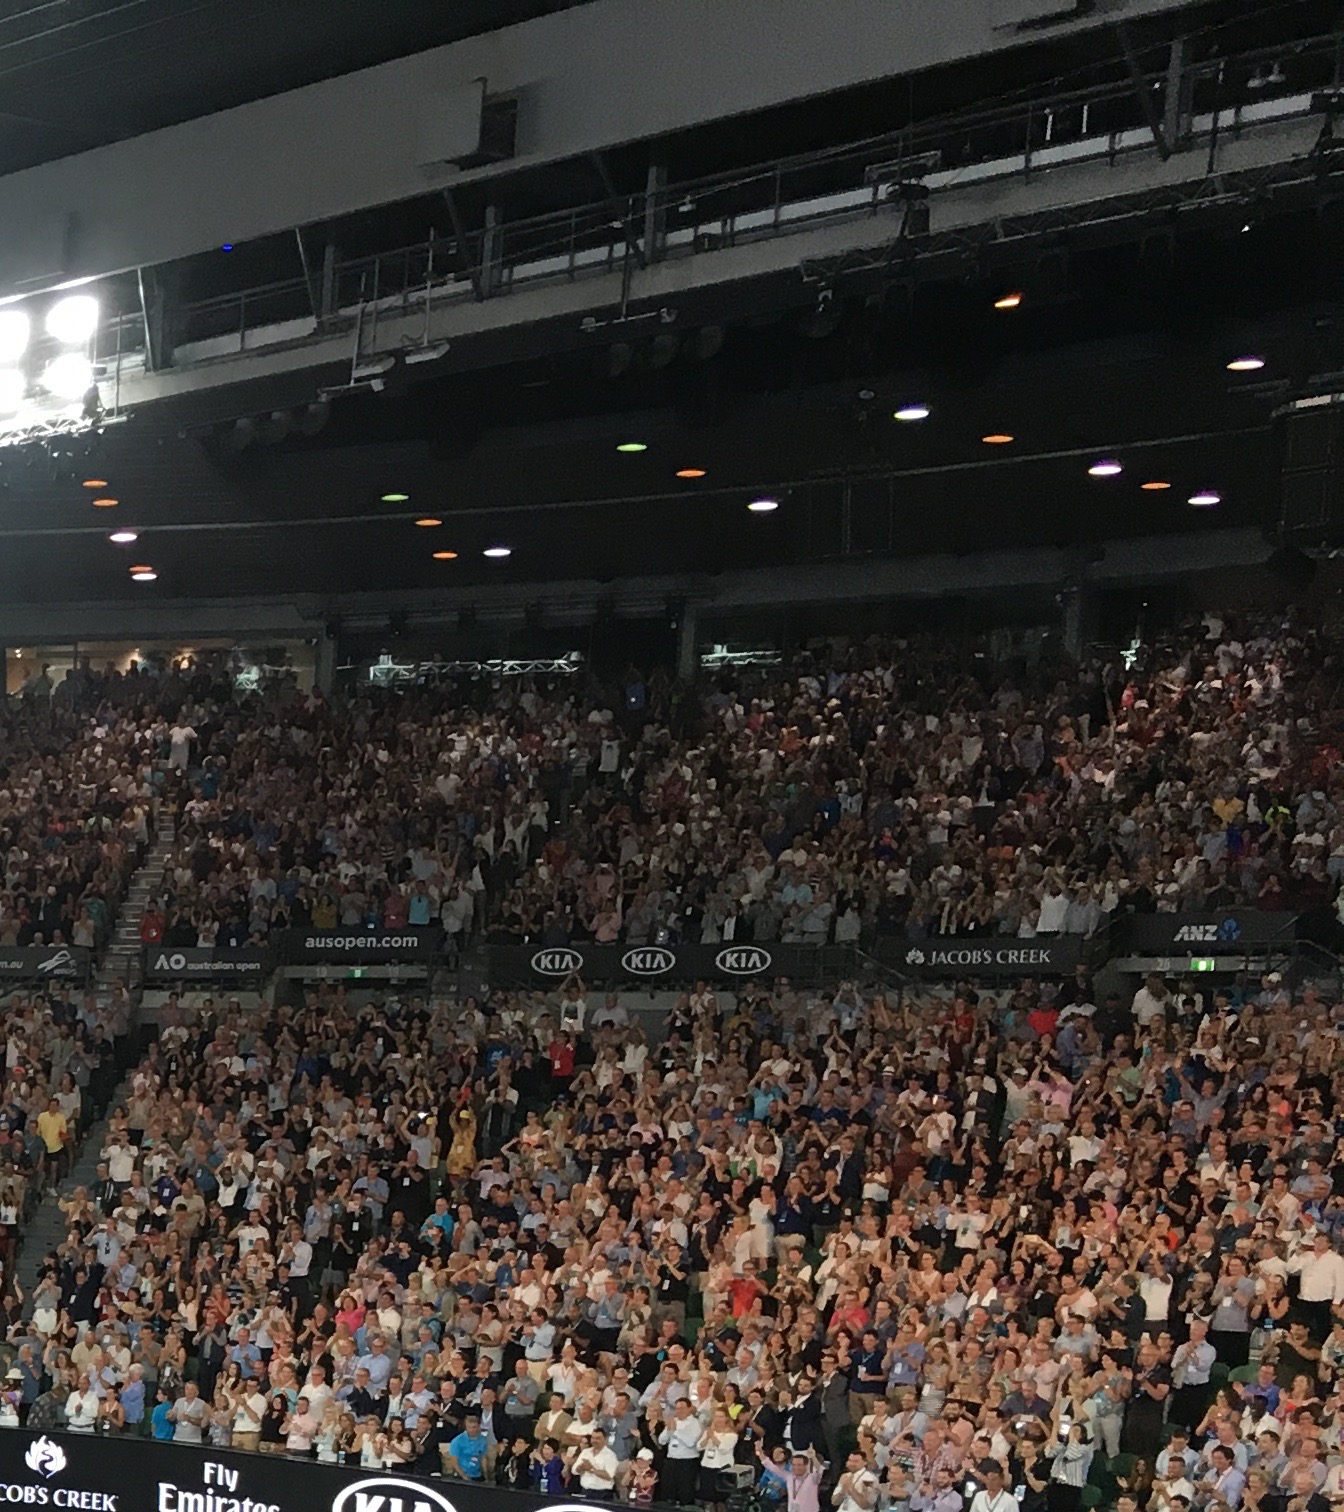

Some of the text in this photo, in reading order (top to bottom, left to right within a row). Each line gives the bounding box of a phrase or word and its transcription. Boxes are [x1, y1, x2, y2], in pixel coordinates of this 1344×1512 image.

[1173, 925, 1218, 942] ANZ
[304, 936, 418, 950] ausopen.com
[154, 954, 186, 970] AO
[540, 955, 574, 969] KIA
[630, 954, 666, 968] KIA
[724, 952, 761, 968] KIA
[927, 949, 1052, 966] JACOB'S CREEK
[203, 1461, 239, 1492] Fly
